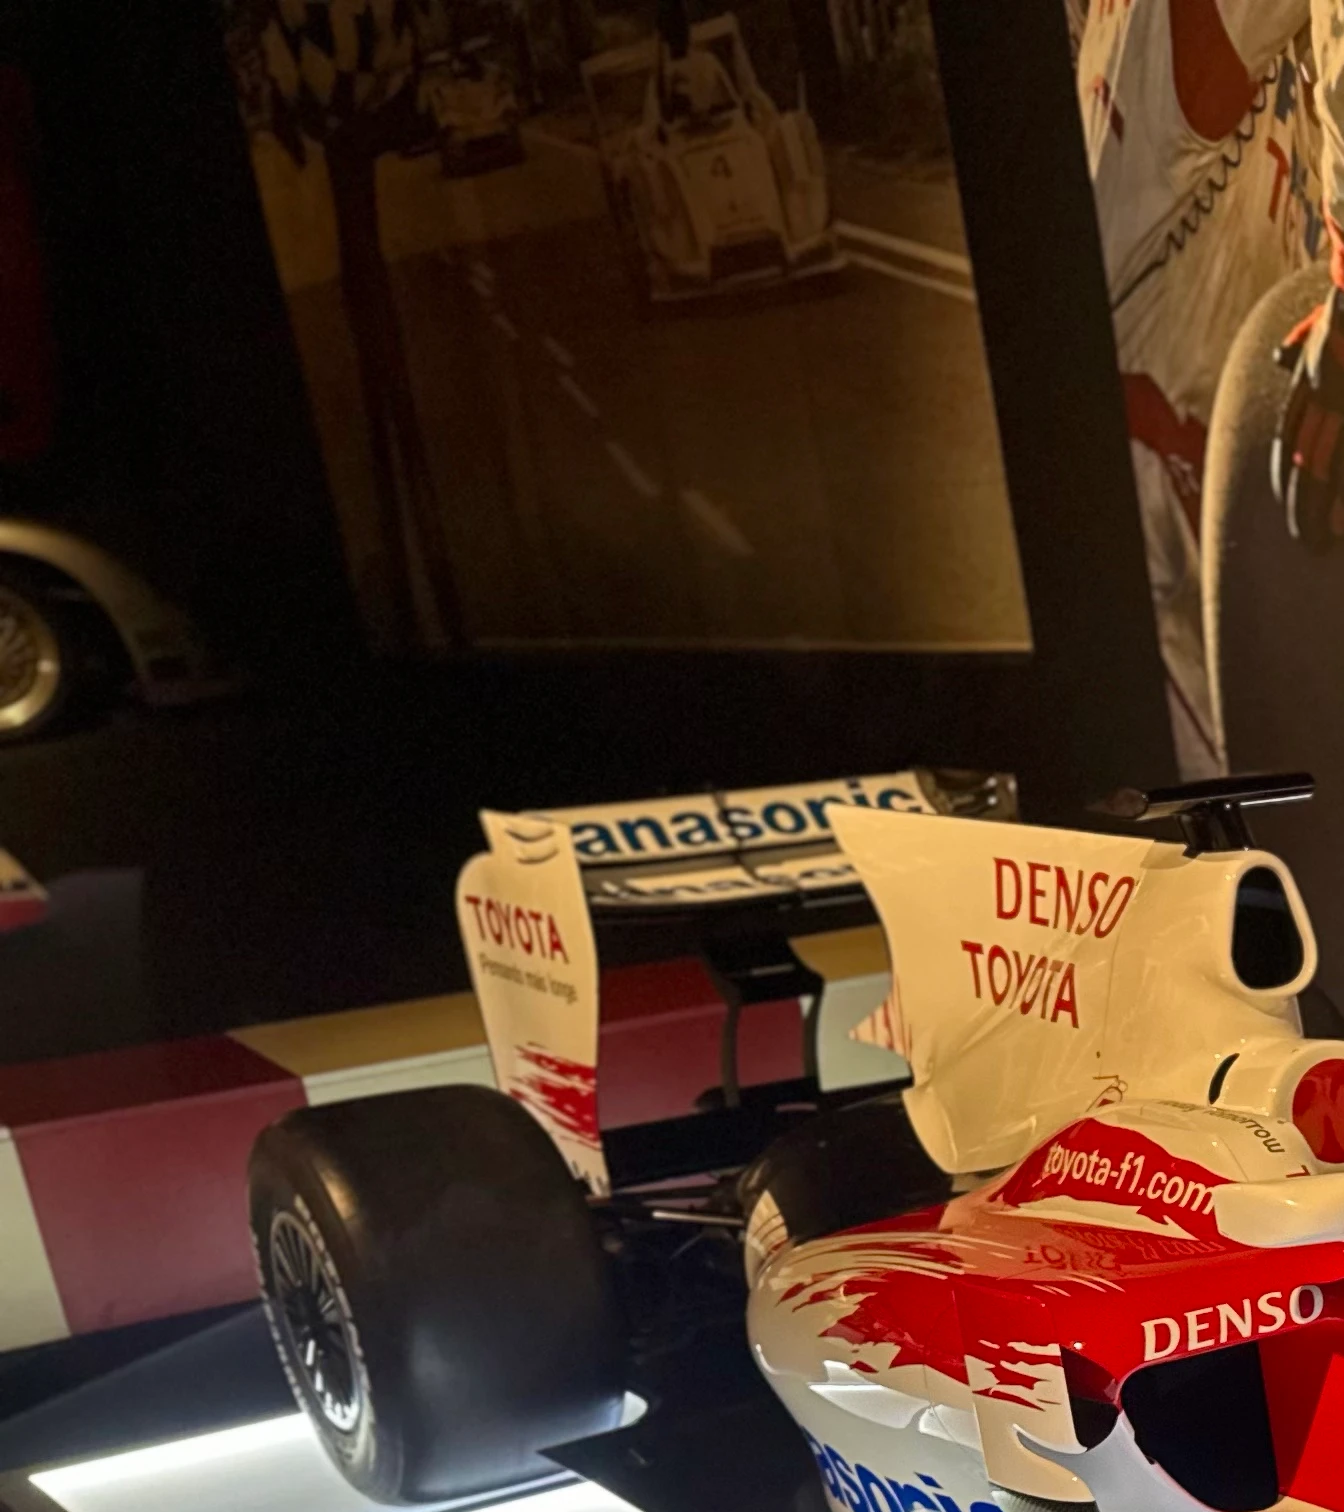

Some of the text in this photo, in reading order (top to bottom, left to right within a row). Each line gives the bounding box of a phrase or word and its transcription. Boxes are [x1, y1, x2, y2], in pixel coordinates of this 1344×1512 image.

[571, 778, 919, 854] anasonic
[465, 895, 570, 965] TOYOTA
[993, 857, 1136, 938] DENSO
[960, 940, 1080, 1029] TOYOTA
[1043, 1141, 1214, 1216] toyota-f1.com
[1140, 1285, 1324, 1362] DENSO
